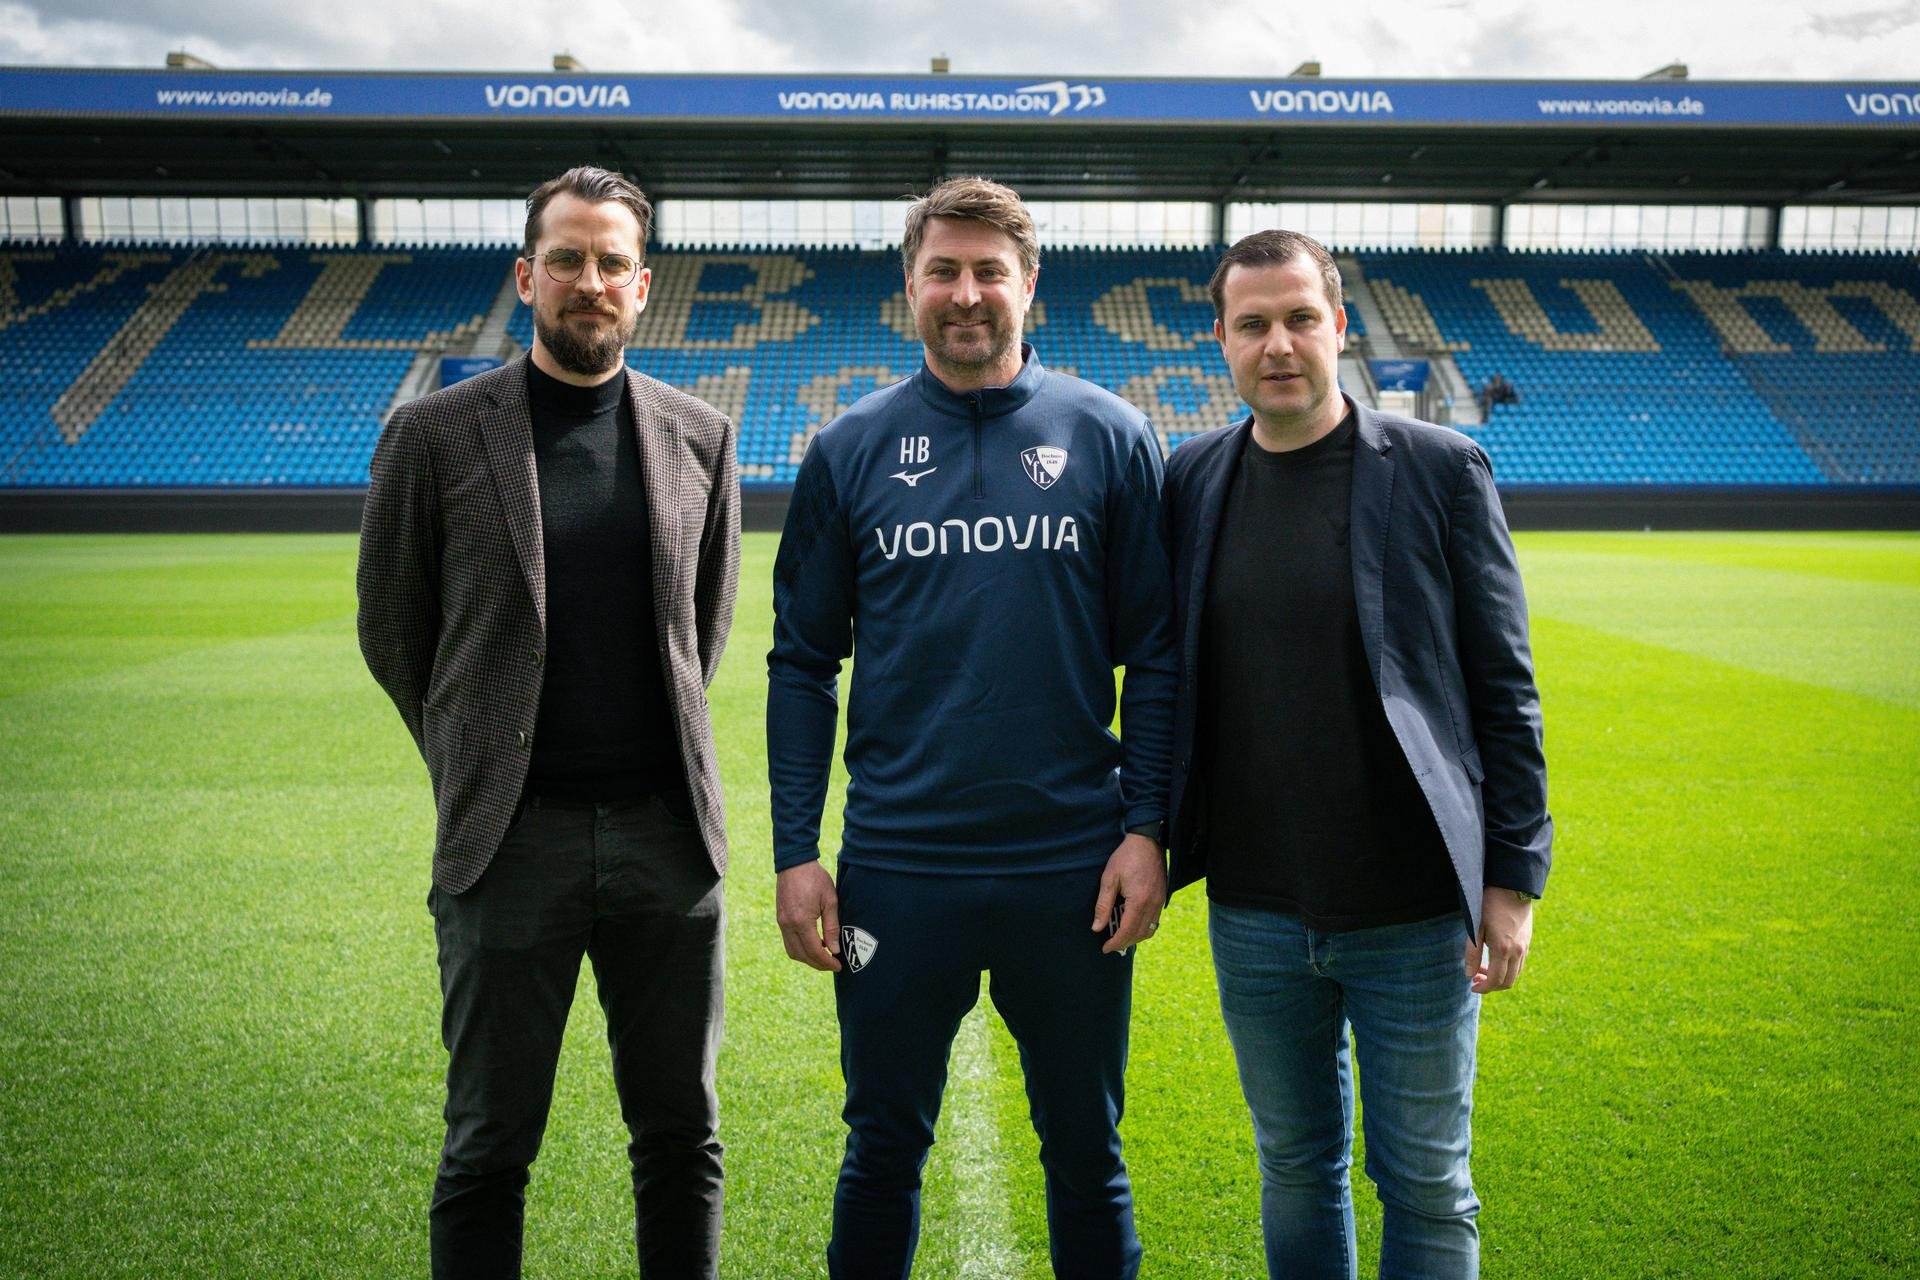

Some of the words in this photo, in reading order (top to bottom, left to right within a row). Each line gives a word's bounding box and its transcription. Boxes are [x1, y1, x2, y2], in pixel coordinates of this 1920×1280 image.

[157, 87, 333, 107] www.vonovia.de
[890, 94, 1050, 111] RUHRSTADION
[1537, 96, 1704, 115] www.vonovia.de
[899, 435, 930, 464] HB
